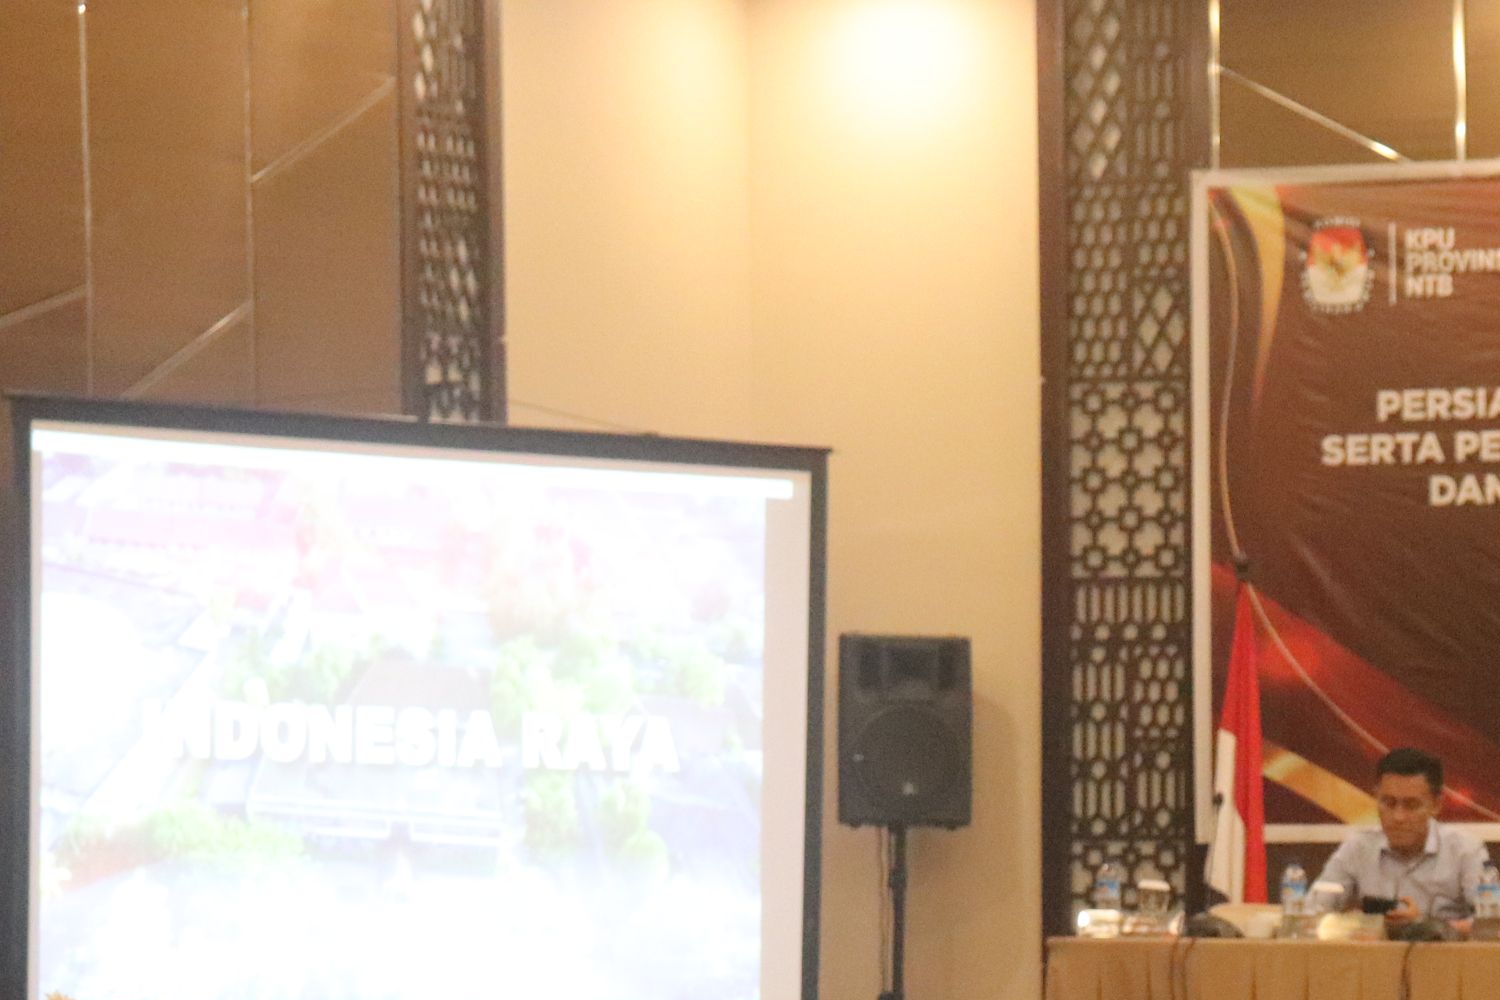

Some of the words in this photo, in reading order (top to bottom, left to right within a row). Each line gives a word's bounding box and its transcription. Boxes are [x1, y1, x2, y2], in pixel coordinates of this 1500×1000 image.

[1404, 227, 1456, 249] KPU
[1404, 273, 1453, 297] NTB
[1321, 431, 1445, 466] SERTA
[522, 710, 680, 772] RAYA
